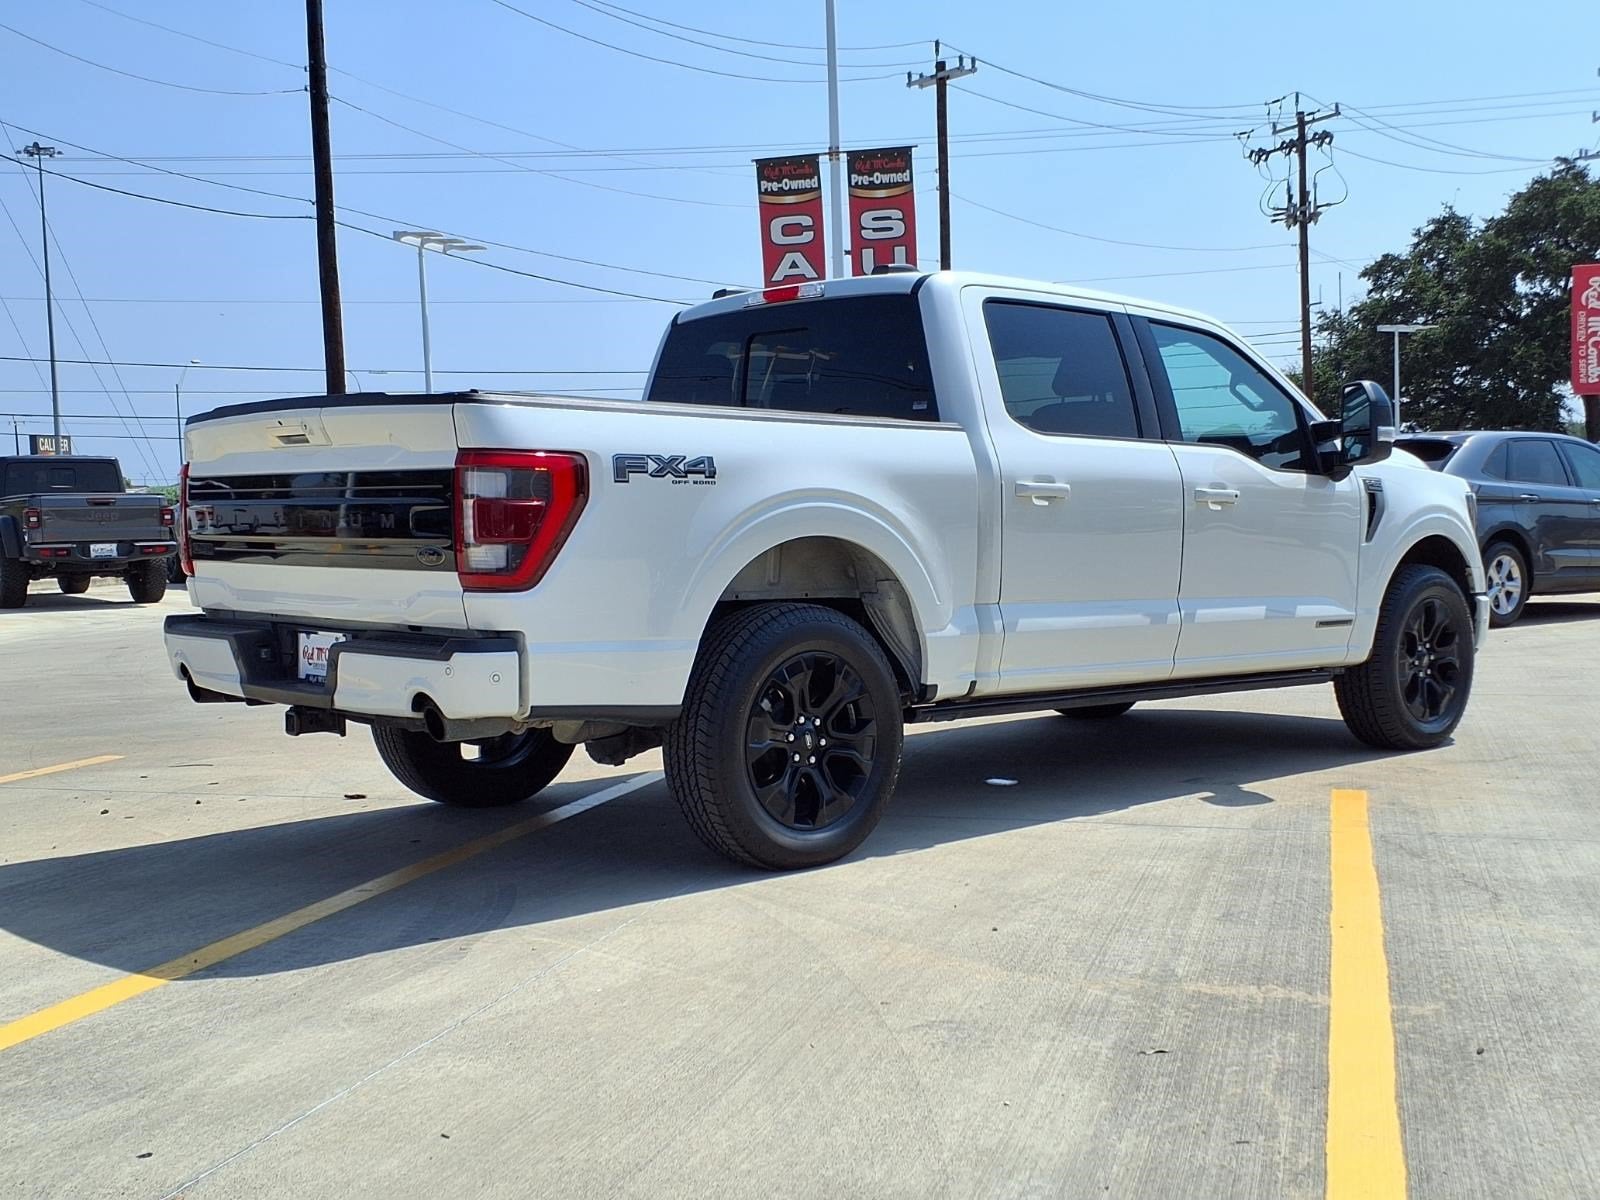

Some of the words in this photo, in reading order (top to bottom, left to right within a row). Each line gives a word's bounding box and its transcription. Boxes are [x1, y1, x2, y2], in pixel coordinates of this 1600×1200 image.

[760, 175, 818, 193] Pre-Owned
[850, 169, 911, 186] Pre-Owned
[1577, 310, 1587, 342] DRIVEN
[1578, 344, 1587, 357] TO
[1579, 358, 1588, 384] SERVE
[39, 437, 70, 452] CALIER
[612, 453, 717, 483] FX4
[87, 510, 119, 521] Jeep
[212, 513, 396, 529] PLATINUM
